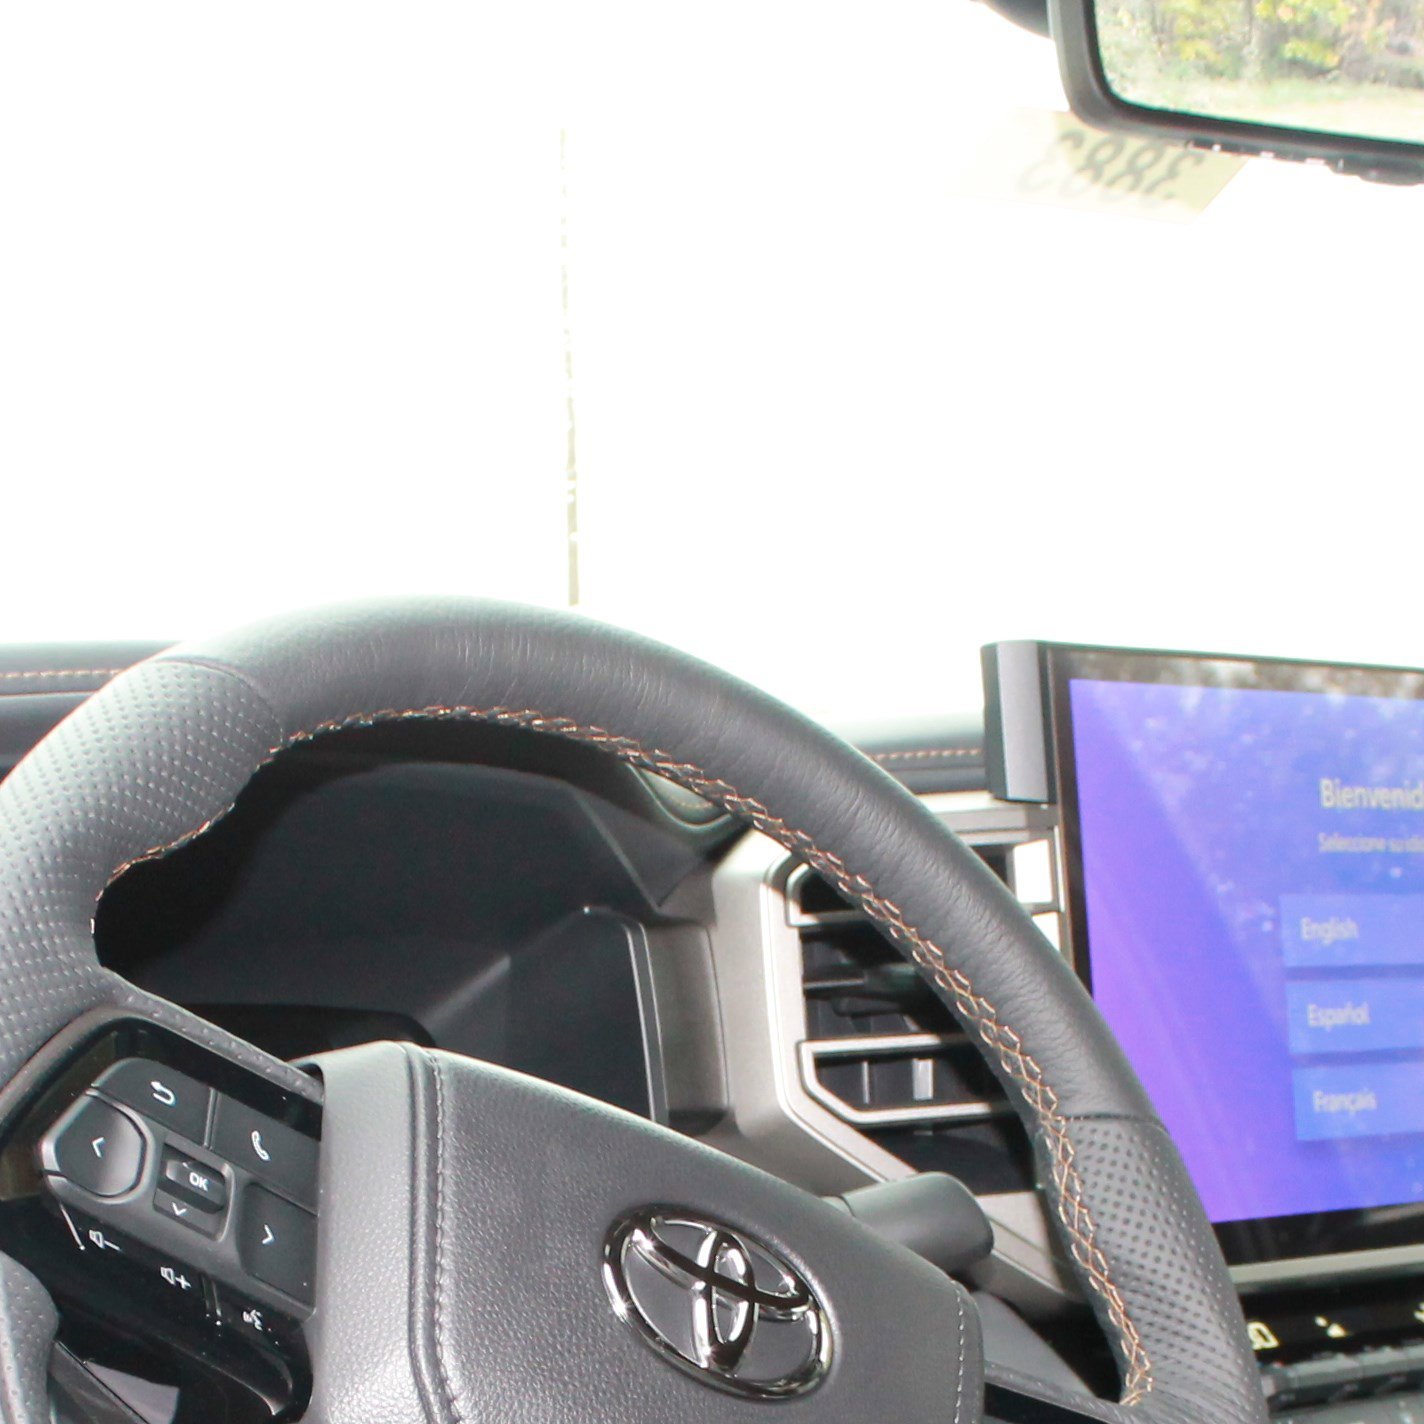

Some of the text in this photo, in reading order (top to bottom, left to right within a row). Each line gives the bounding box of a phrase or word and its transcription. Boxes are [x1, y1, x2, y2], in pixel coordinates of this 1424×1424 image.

[1301, 917, 1359, 946] English
[1308, 1001, 1370, 1031] Español
[1313, 1087, 1377, 1117] Français
[189, 1171, 208, 1192] OK
